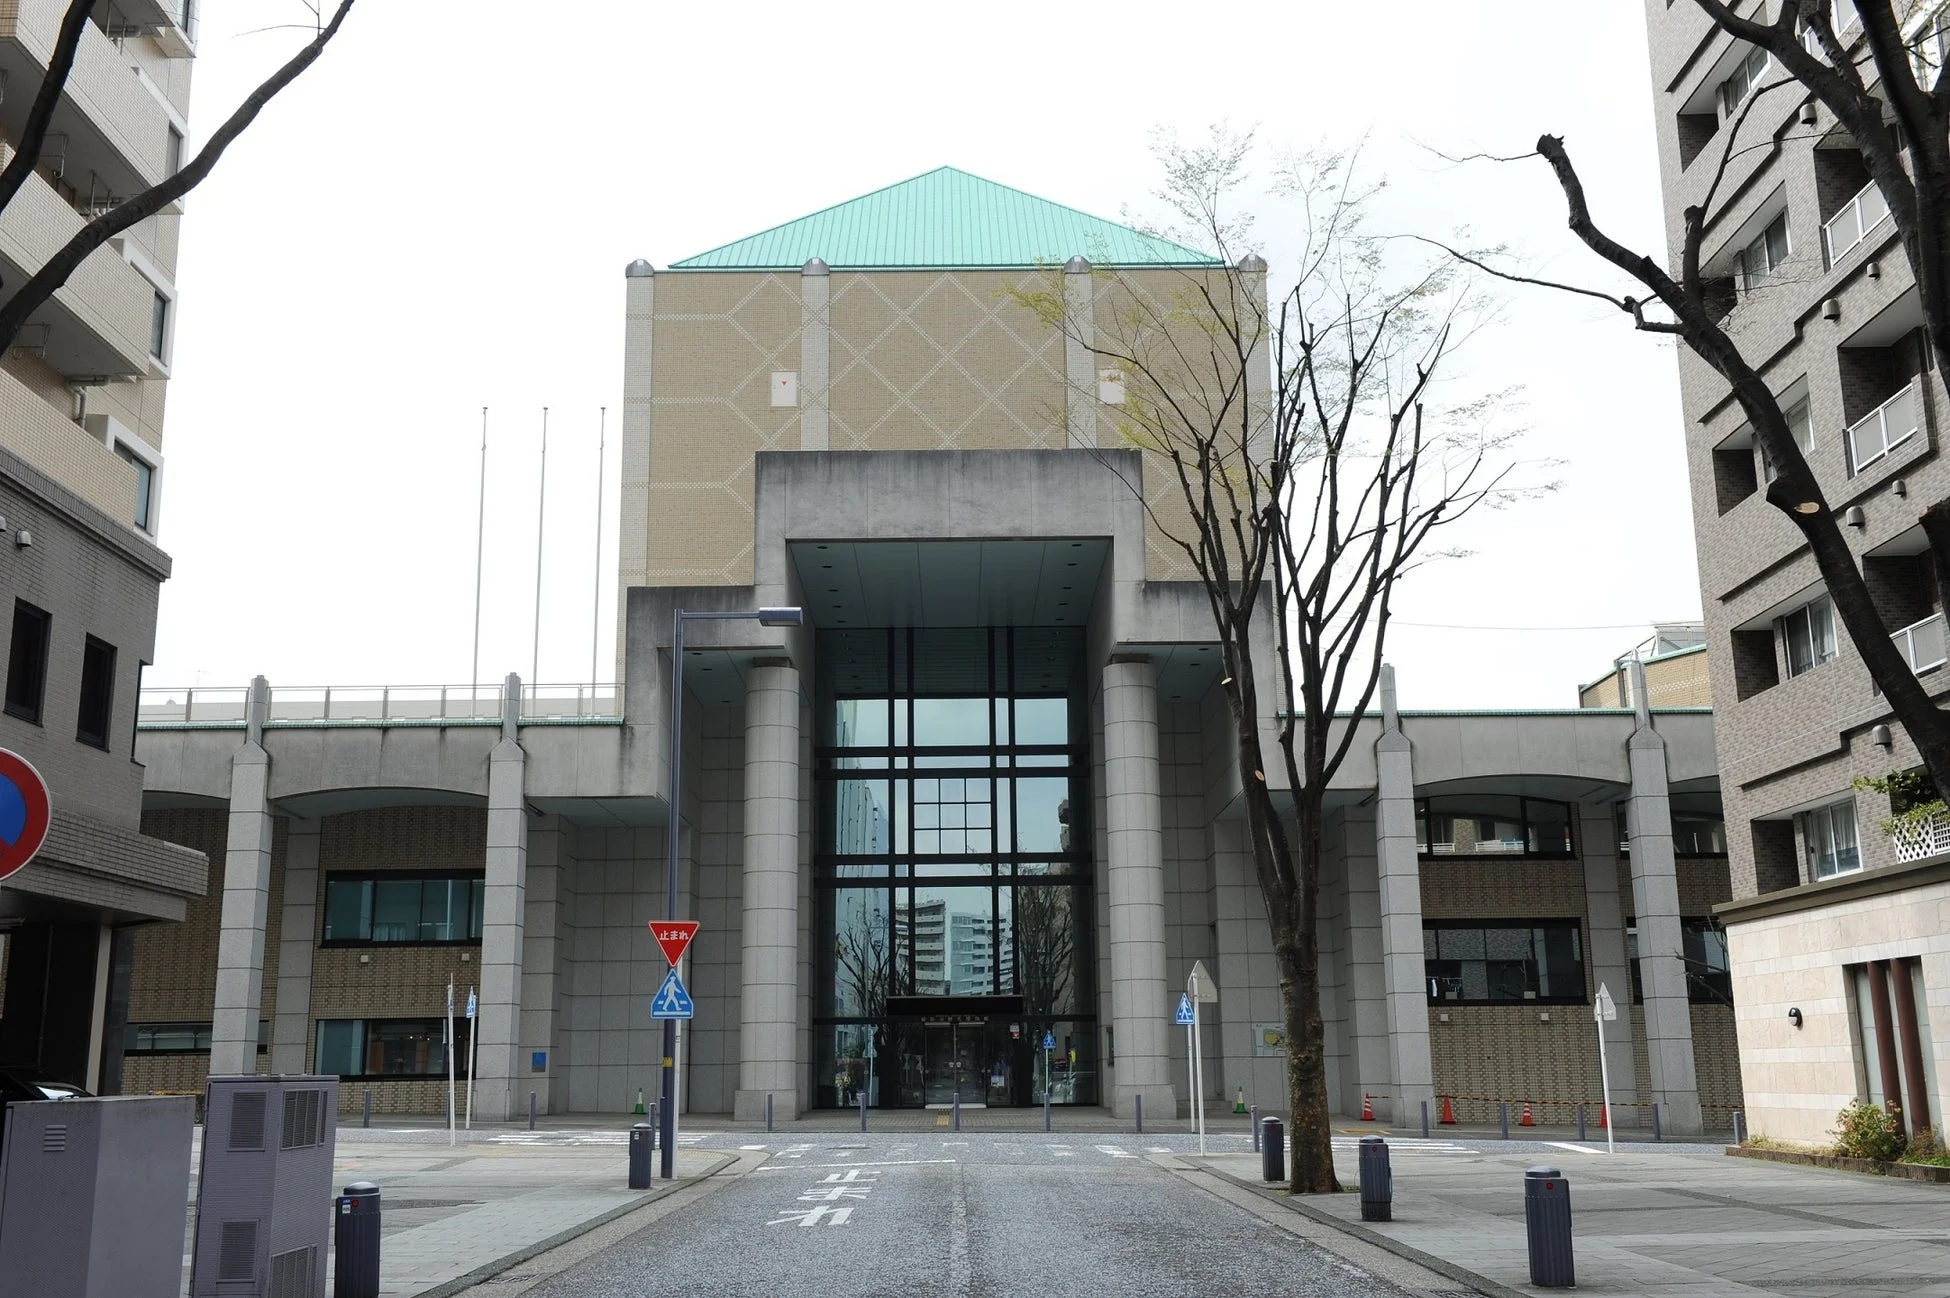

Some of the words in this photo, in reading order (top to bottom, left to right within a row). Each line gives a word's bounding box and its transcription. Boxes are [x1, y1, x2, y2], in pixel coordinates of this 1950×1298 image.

[659, 930, 689, 941] 止まれ
[766, 1168, 881, 1227] 止まれ
